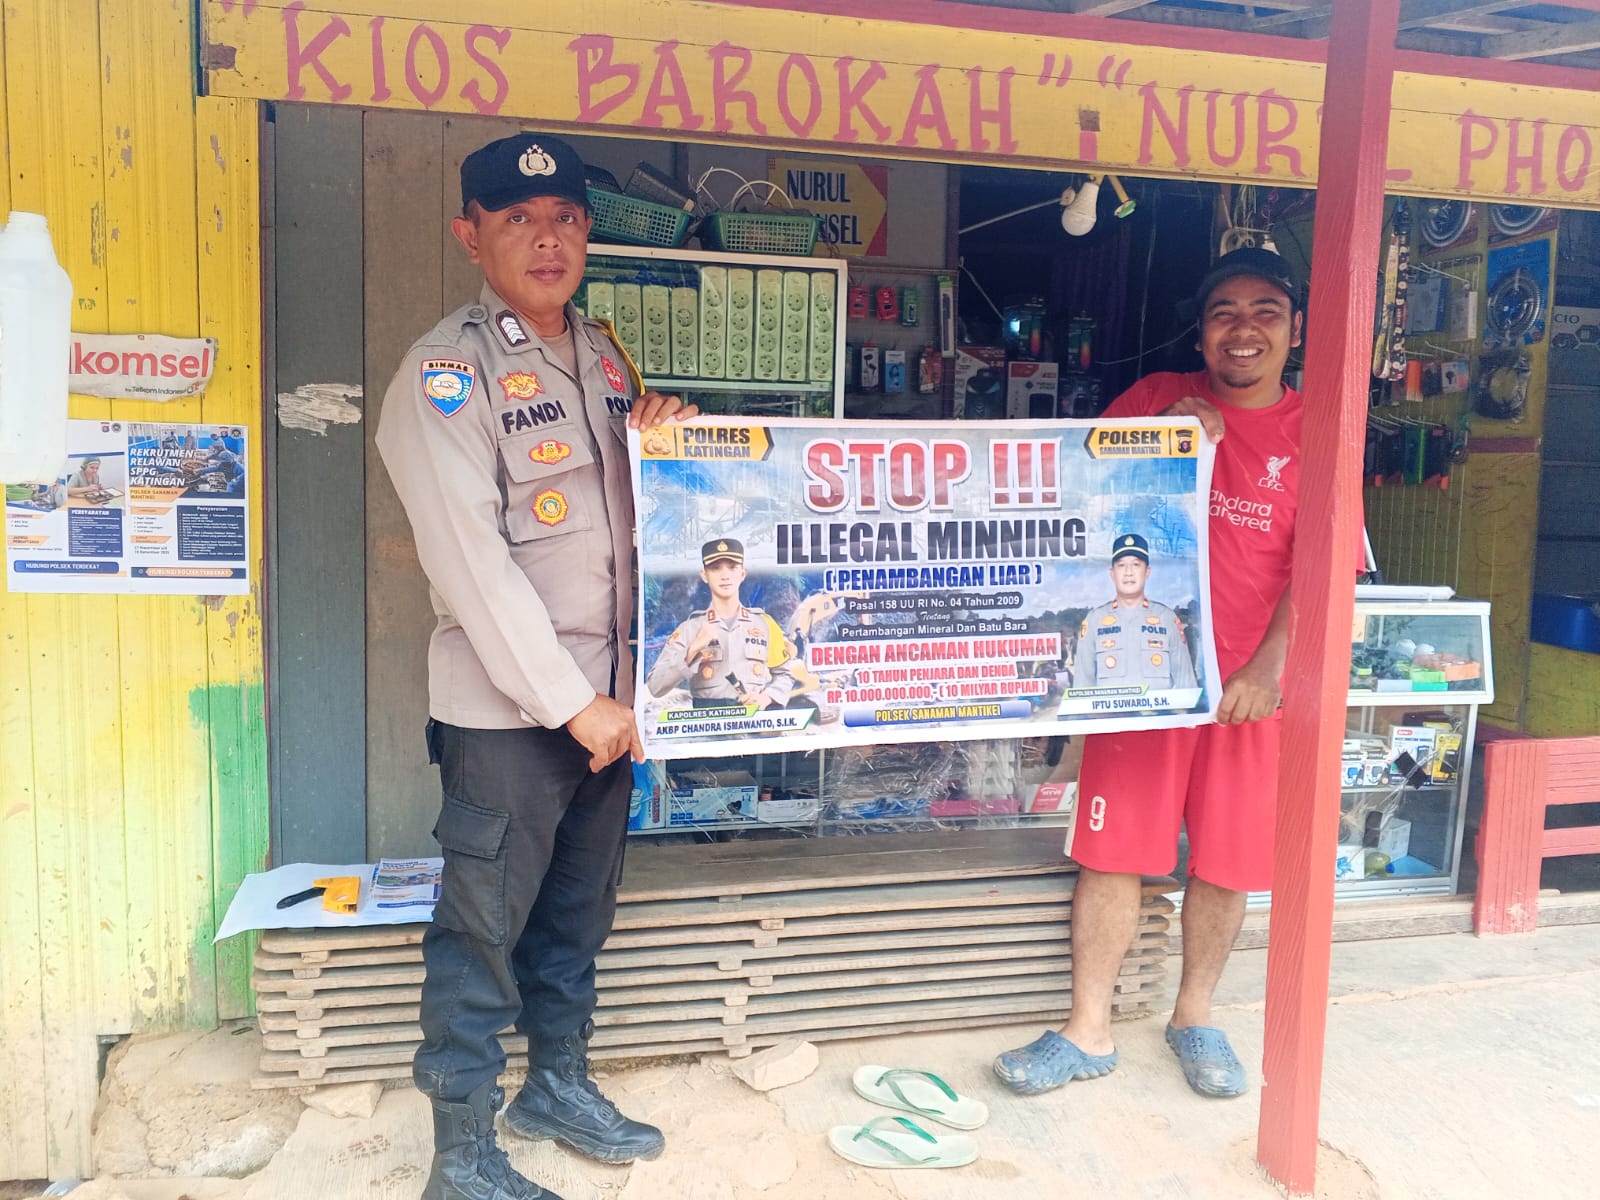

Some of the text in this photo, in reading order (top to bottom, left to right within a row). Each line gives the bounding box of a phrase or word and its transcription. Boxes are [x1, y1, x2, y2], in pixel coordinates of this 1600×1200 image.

[786, 169, 851, 203] NURUL
[69, 342, 210, 378] komsel
[428, 362, 468, 372] BINMAS
[501, 401, 567, 434] FANDI
[683, 427, 750, 444] POLRES
[1099, 431, 1161, 445] POLSEK
[130, 448, 193, 458] REKRUTMEN
[684, 445, 750, 457] KATINGAN
[130, 457, 180, 467] RELAWAN
[130, 467, 156, 476] SPPG
[805, 440, 1059, 510] STOP !!!
[130, 476, 185, 486] KATINGAN
[776, 518, 1086, 565] ILLEGAL MINNING
[849, 596, 1020, 611] Pasal 158 UU RI No. 04 Tahun 2009
[920, 611, 951, 622] Tentang
[842, 621, 1027, 638] Pertambangan Mineral Dan Batu Bara
[1141, 625, 1167, 635] POLRI
[811, 637, 1058, 666] DENGAN ANCAMAN HUKUMAN
[857, 663, 1016, 684] 10 TAHUN PENJARA DAN DENDA
[827, 690, 842, 704] RP.
[960, 683, 998, 697] MILYAR
[1000, 681, 1039, 695] RUPIAH
[1091, 697, 1170, 710] IPTU SUWARDI, S.H.
[668, 707, 746, 720] KAPOLRES KATINGAN
[875, 704, 1001, 722] POLSEK SANAMAN MANTIKEI
[656, 717, 798, 736] AKBP CHANDRA ISMAWANTO, S.I.K.
[1088, 795, 1107, 832] 9
